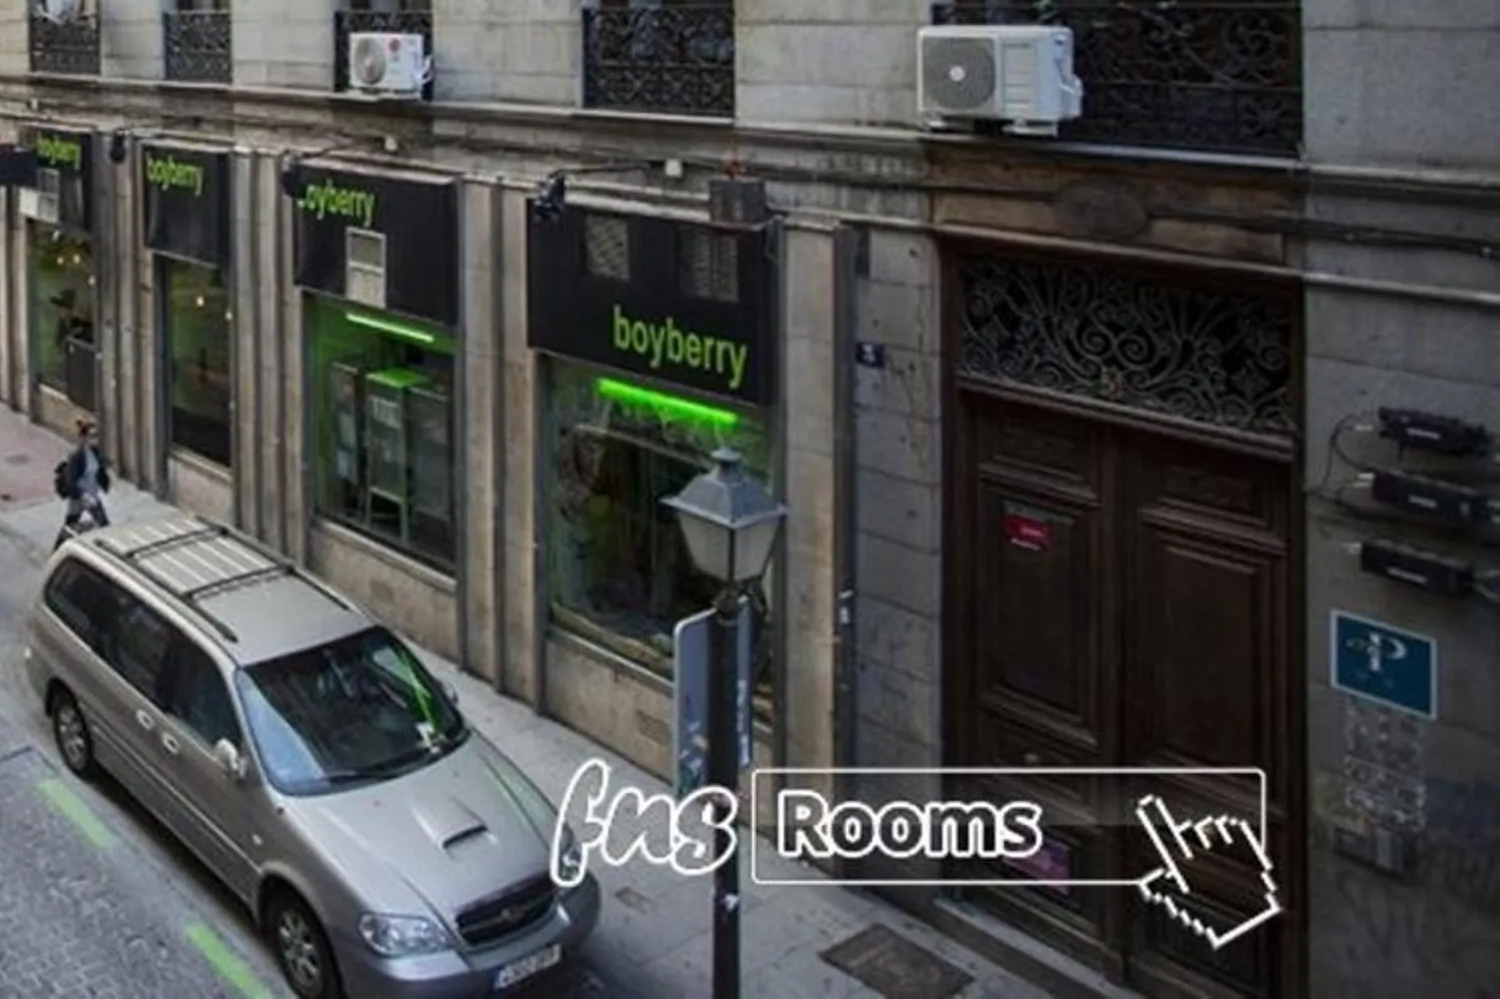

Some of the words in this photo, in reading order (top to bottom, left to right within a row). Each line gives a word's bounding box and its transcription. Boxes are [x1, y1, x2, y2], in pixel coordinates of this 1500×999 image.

[146, 150, 203, 197] boyberry
[297, 177, 375, 229] oyberry
[613, 303, 747, 390] boyberry
